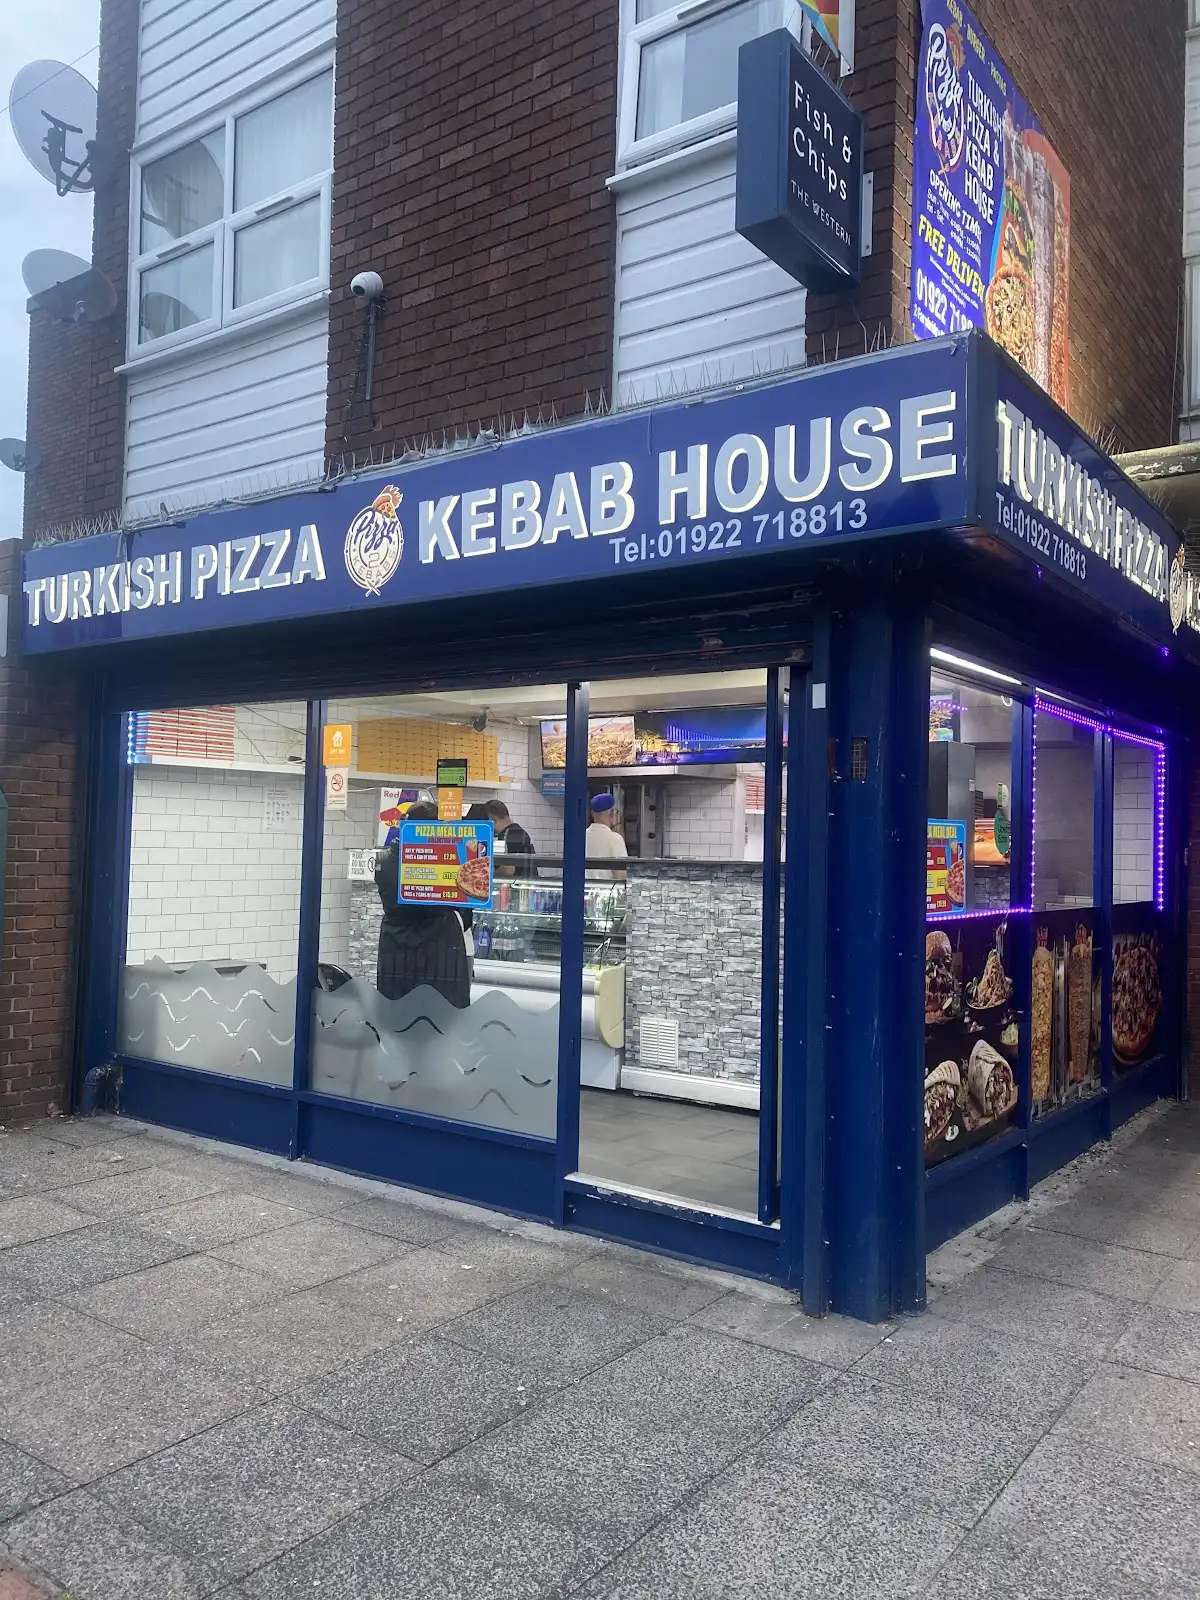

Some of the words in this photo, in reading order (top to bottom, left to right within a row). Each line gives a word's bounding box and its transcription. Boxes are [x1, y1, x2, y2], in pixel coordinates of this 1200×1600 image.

[794, 80, 834, 146] Fish
[842, 135, 852, 164] &
[967, 103, 991, 158] PIZZA
[993, 139, 1000, 168] &
[968, 70, 1002, 142] TURKISH
[793, 127, 848, 201] Chips
[929, 169, 961, 218] OPENING
[791, 180, 809, 208] THE
[812, 199, 851, 246] WESTERN
[919, 214, 946, 258] FREE
[917, 267, 947, 326] 01922
[418, 461, 635, 565] KEBAB
[658, 389, 957, 525] HOUSE
[995, 399, 1117, 568] TURKISH
[1115, 506, 1169, 603] PIZZA
[351, 506, 399, 554] Pizza
[609, 518, 742, 564] Tel:01922
[752, 498, 868, 543] 718813
[995, 491, 1050, 556] Tel:01922
[1052, 533, 1086, 580] 718813
[22, 550, 182, 627] TURKISH
[190, 523, 327, 600] PIZZA
[352, 549, 396, 580] KEBABS
[383, 790, 400, 798] Red
[415, 826, 435, 837] PIZZA
[437, 826, 457, 838] MEAL
[458, 826, 477, 838] DEAL
